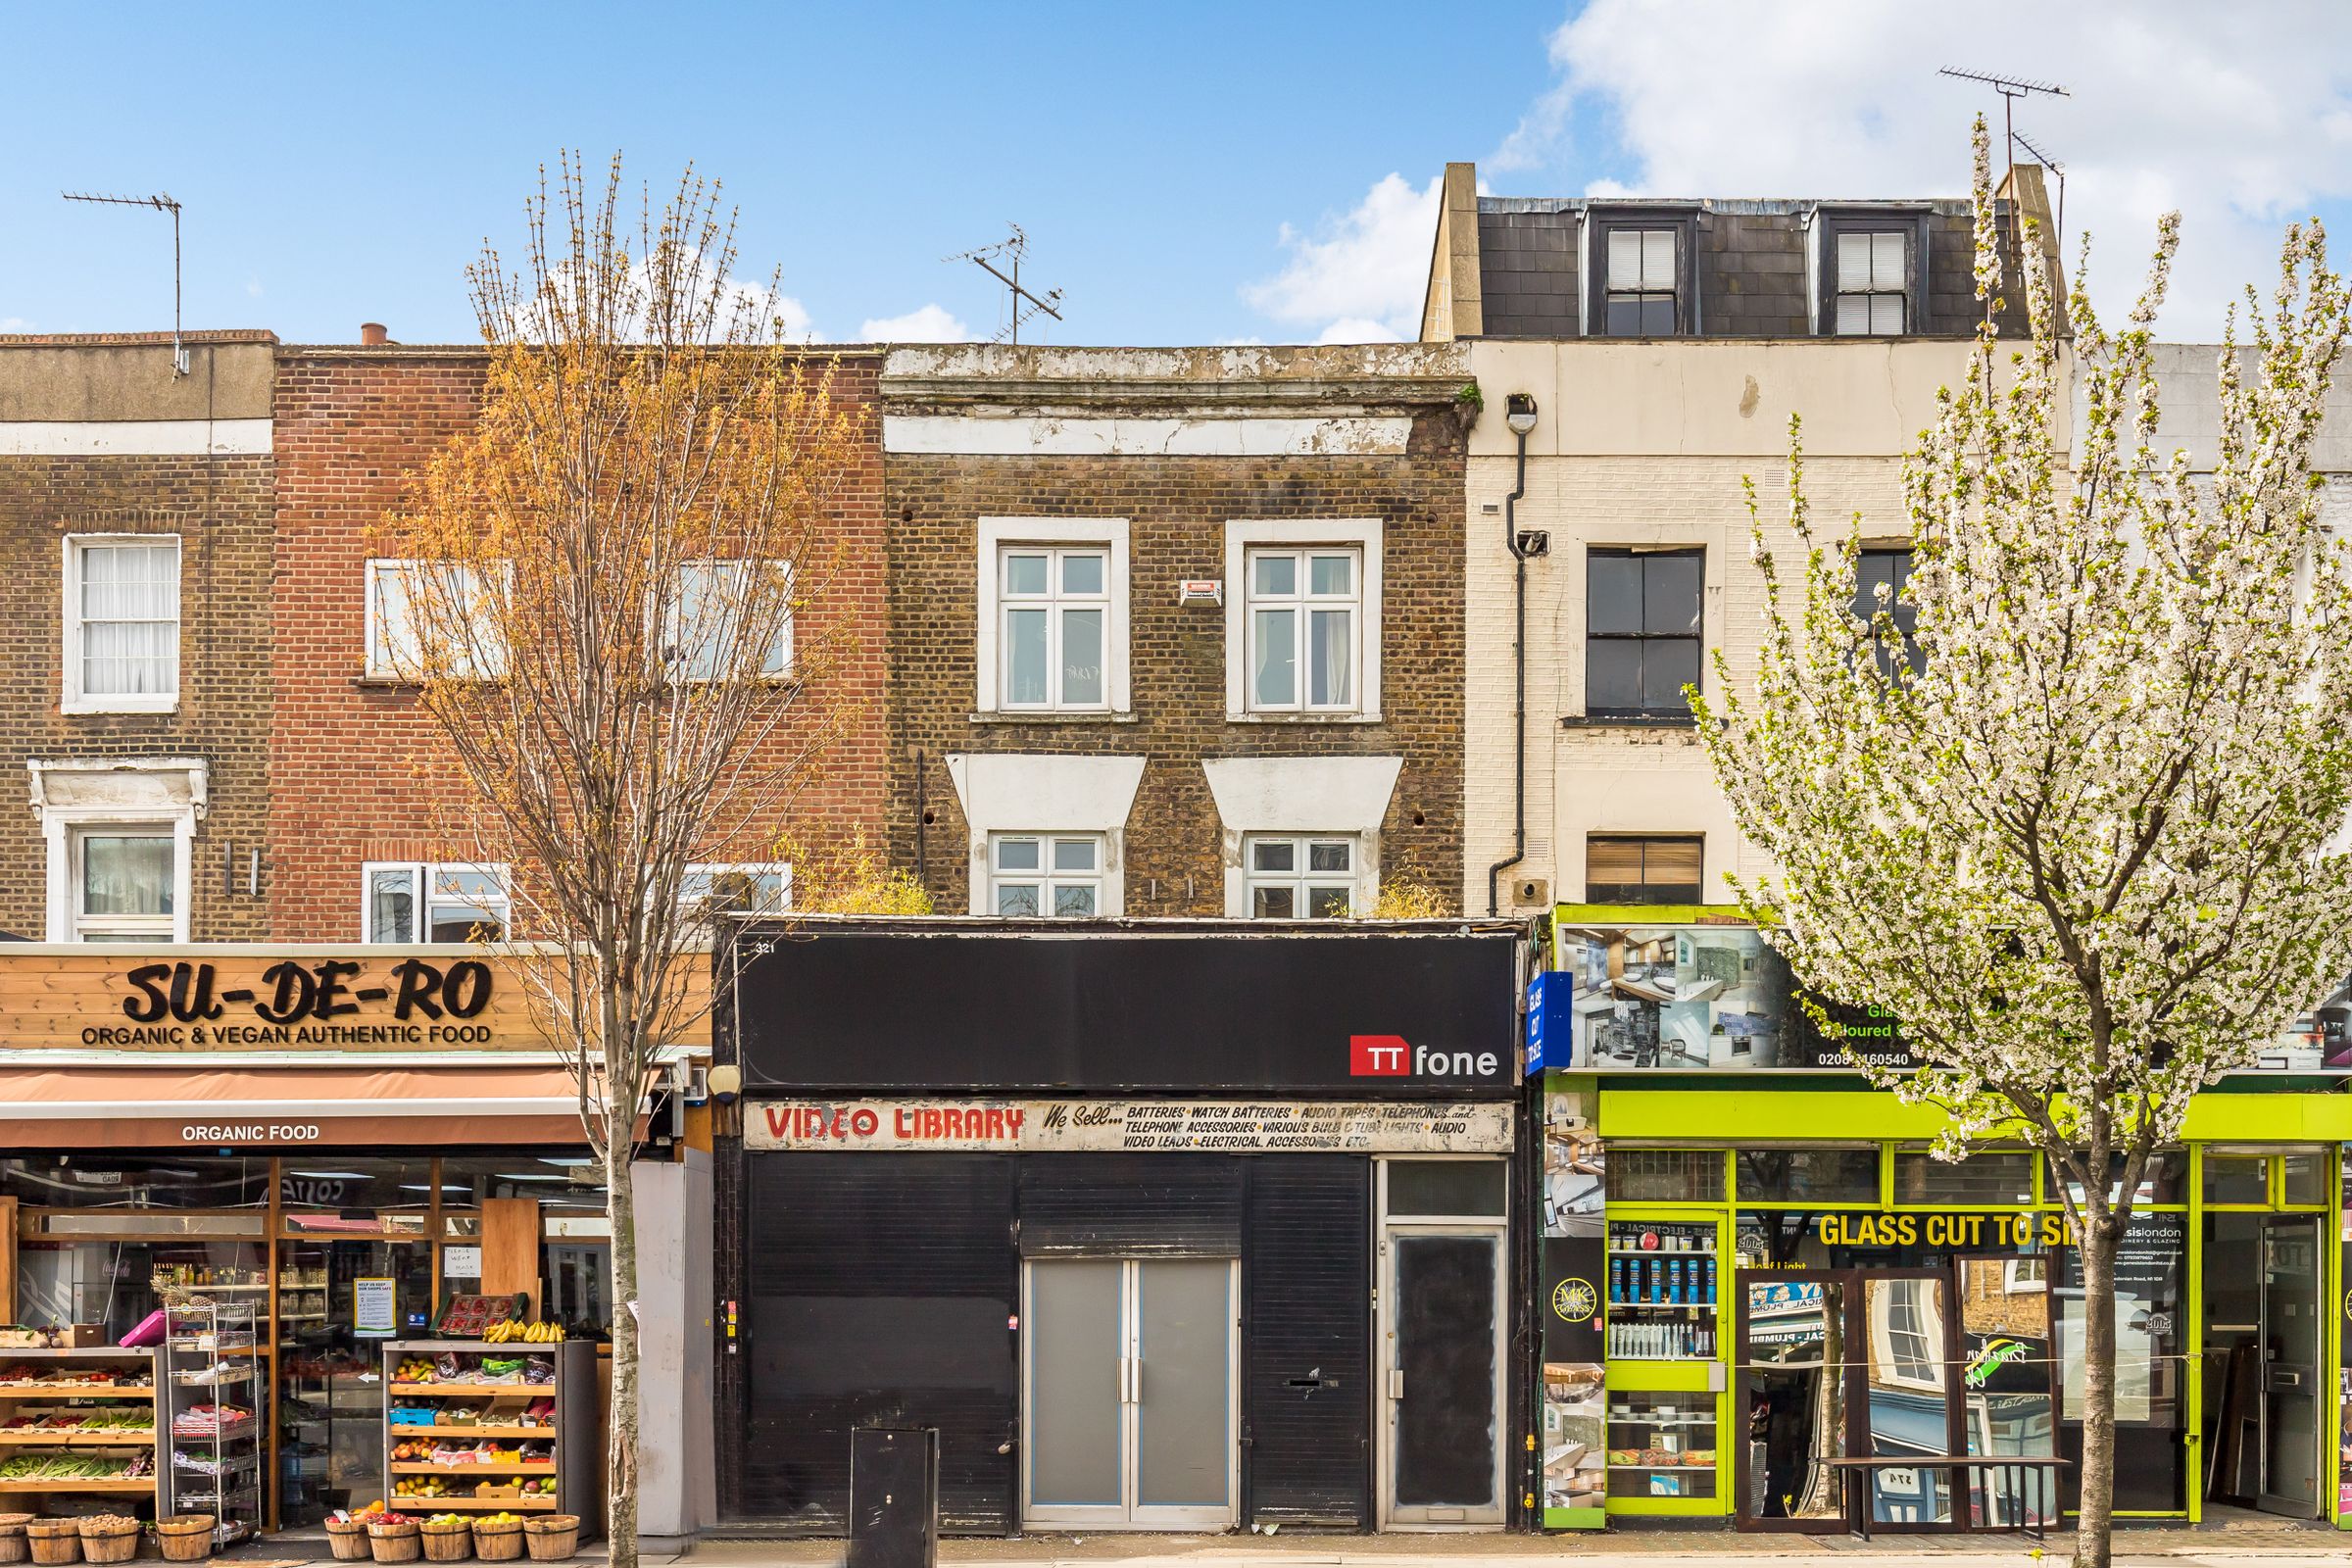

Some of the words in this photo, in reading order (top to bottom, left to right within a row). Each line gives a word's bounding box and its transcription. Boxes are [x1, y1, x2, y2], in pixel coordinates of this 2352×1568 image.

[756, 942, 774, 954] 321
[122, 958, 494, 1025] SU-DE-RO
[81, 1027, 184, 1045] ORGANIC
[191, 1026, 206, 1044] &
[213, 1026, 289, 1044] VEGAN
[296, 1025, 421, 1044] AUTHENTIC
[429, 1025, 491, 1043] FOOD
[1819, 1054, 1908, 1065] 0208160540
[1044, 1103, 1067, 1128] We
[1127, 1106, 1186, 1119] BATTERIES
[1191, 1106, 1229, 1119] WATCH
[1232, 1106, 1292, 1119] BATTERIES
[1301, 1106, 1337, 1119] AUDIO
[1342, 1106, 1376, 1119] TAPES
[1382, 1106, 1448, 1119] TELEPHONES
[766, 1108, 879, 1138] VIDEO
[894, 1108, 1024, 1139] LIBRARY
[1125, 1121, 1183, 1133] TELEPHONE
[1186, 1121, 1256, 1133] ACCESSORIES
[1262, 1121, 1309, 1133] VARIOUS
[1311, 1121, 1343, 1134] BULB
[1430, 1122, 1466, 1134] AUDIO
[182, 1125, 264, 1141] ORGANIC
[270, 1125, 319, 1140] FOOD
[1123, 1135, 1154, 1148] VIDEO
[1157, 1135, 1193, 1148] LEADS
[1820, 1214, 1916, 1246] GLASS
[1927, 1214, 1984, 1246] CUT
[1993, 1214, 2032, 1246] TO
[2041, 1214, 2086, 1246] SI
[1559, 1287, 1590, 1302] MK
